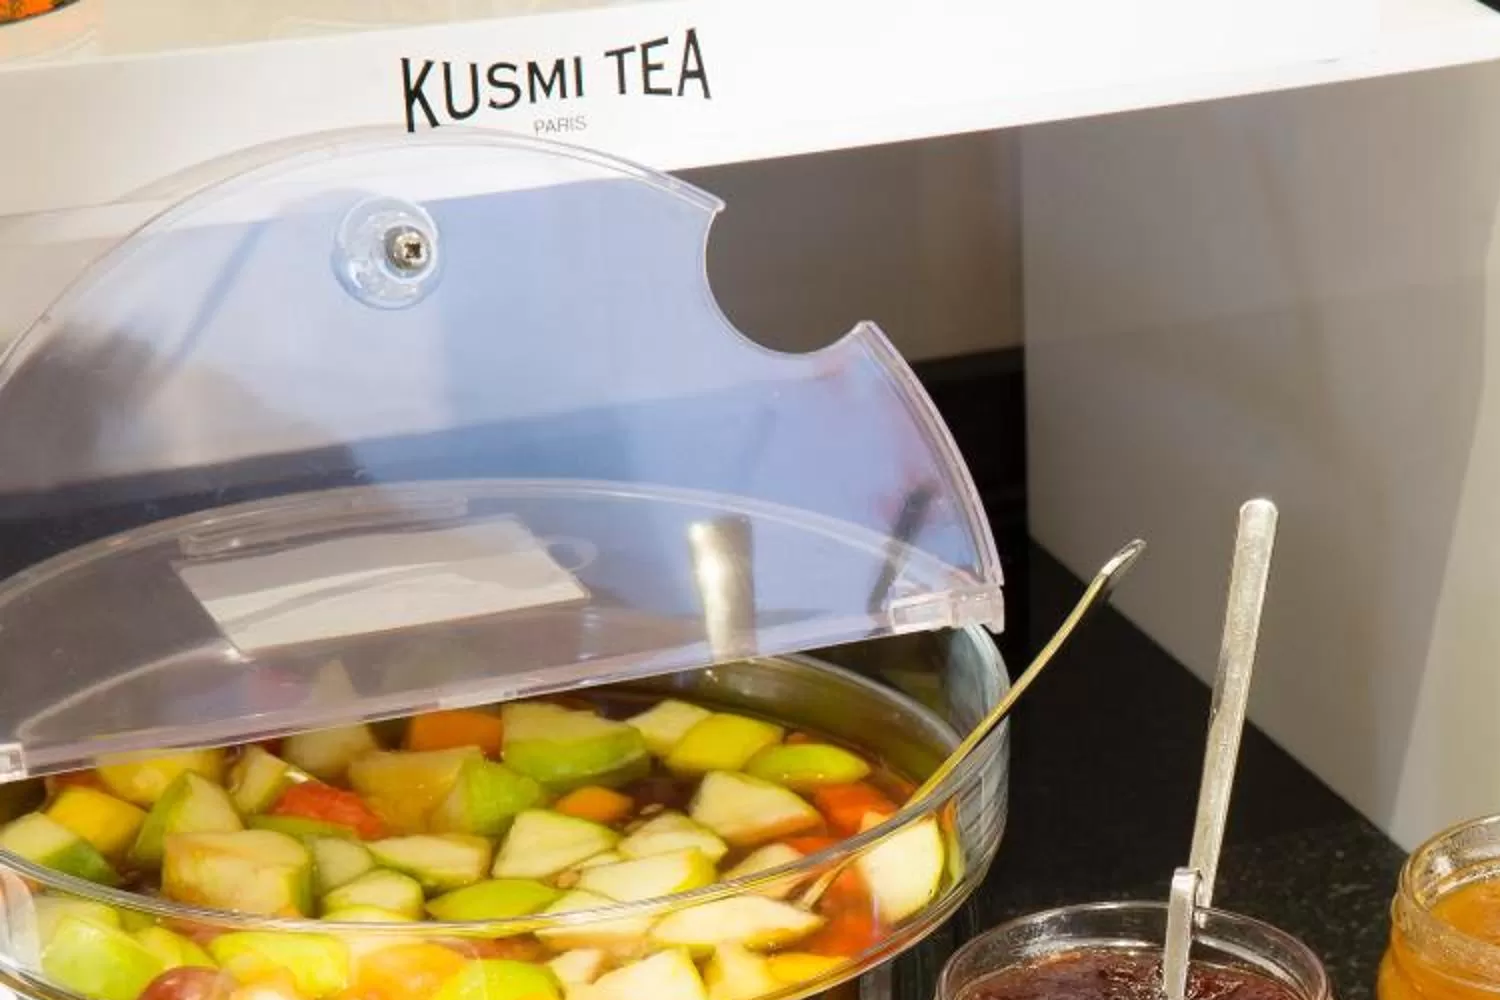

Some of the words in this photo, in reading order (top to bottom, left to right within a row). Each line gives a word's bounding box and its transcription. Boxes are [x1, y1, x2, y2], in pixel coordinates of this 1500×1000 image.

[401, 56, 585, 134] KUSMI
[604, 27, 711, 100] TEA
[534, 115, 588, 137] PARIS
